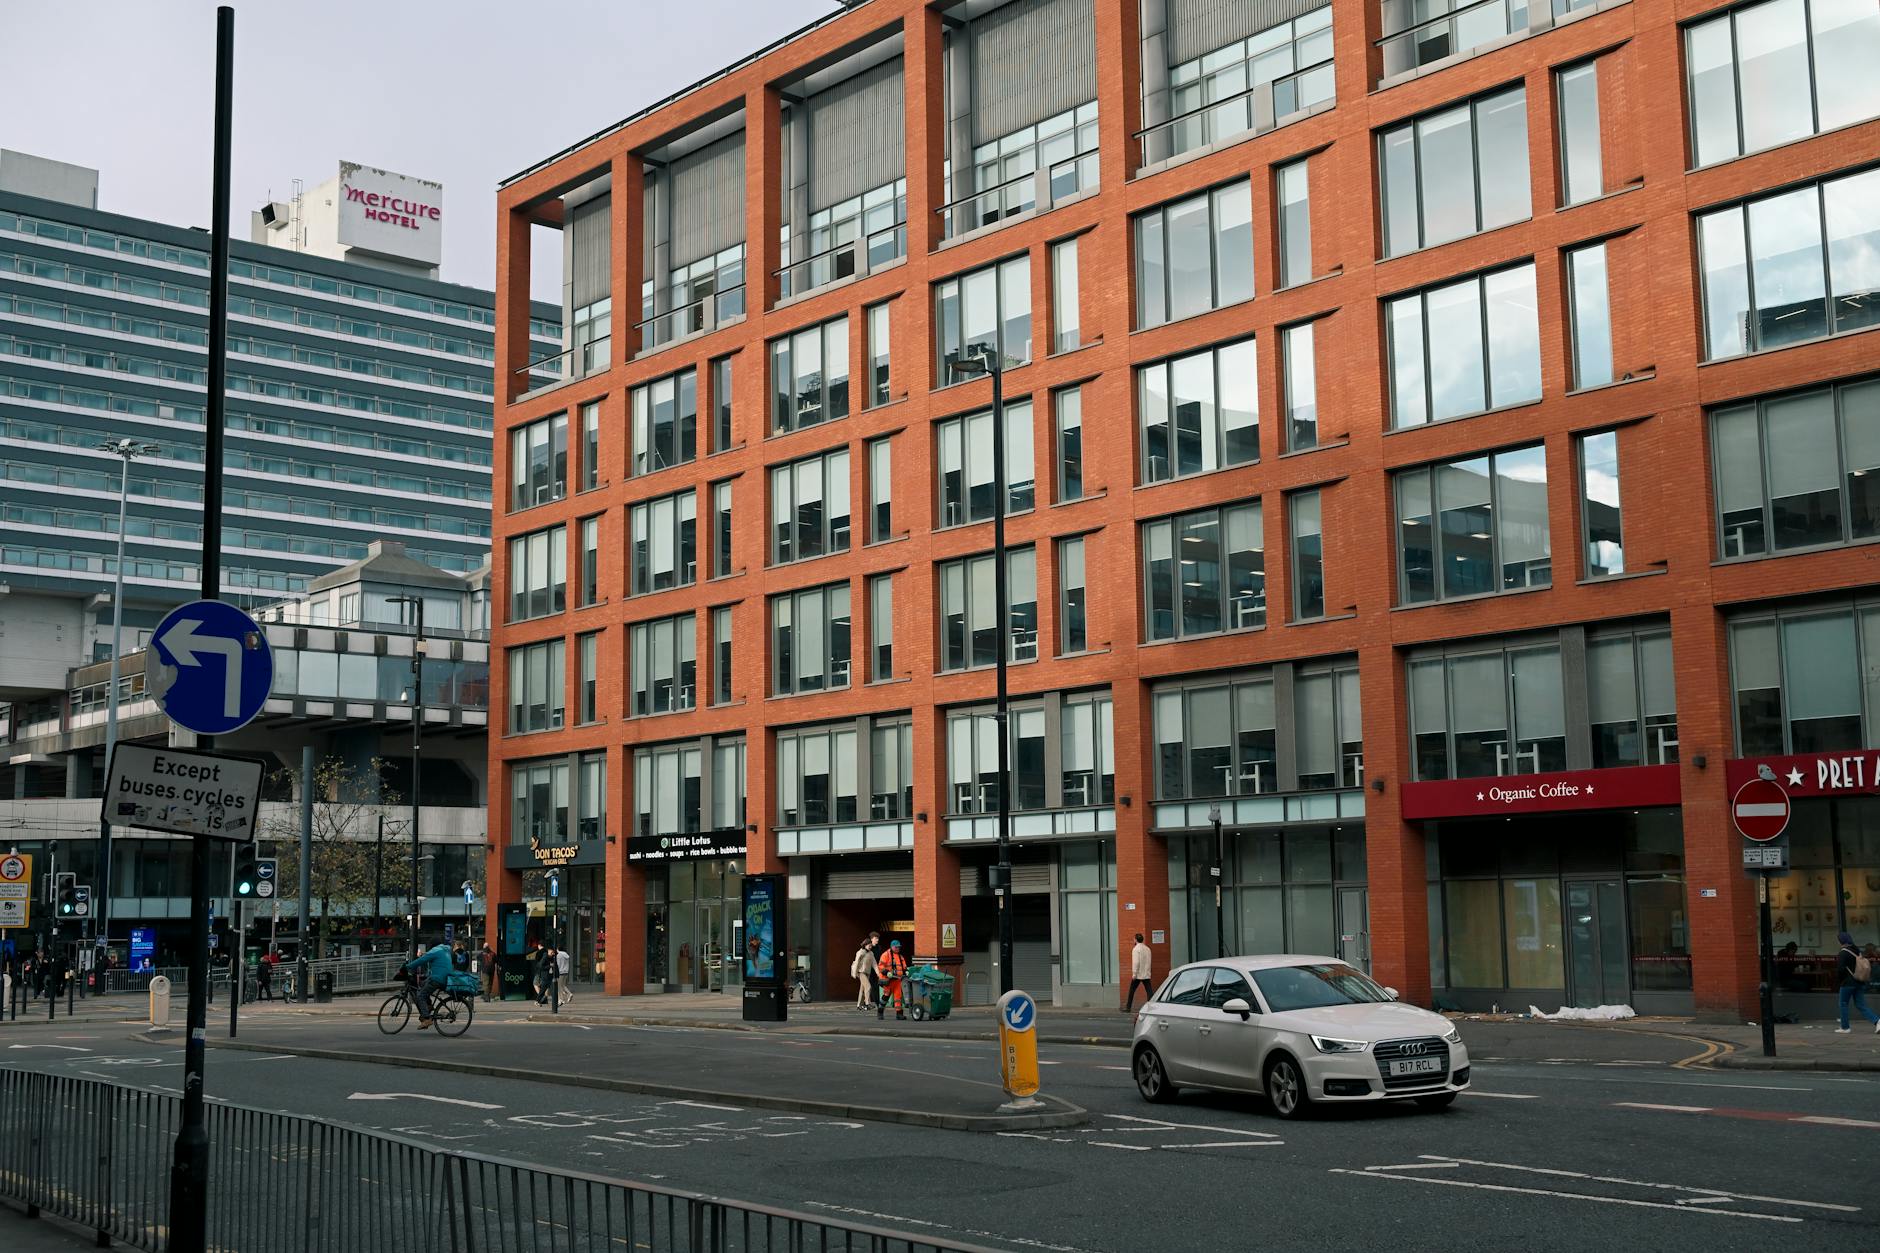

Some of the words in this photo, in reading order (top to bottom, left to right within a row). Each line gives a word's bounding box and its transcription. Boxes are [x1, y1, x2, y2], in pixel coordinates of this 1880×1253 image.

[365, 208, 419, 230] HOTEL
[153, 756, 221, 782] Except
[1817, 756, 1864, 789] PRET
[183, 788, 245, 808] cycles
[1489, 785, 1536, 804] Organic
[1539, 781, 1579, 798] Coffee
[672, 837, 690, 847] Little
[691, 836, 711, 846] Lotus
[535, 848, 550, 859] DON
[629, 851, 642, 859] sushi
[645, 850, 664, 859] noodles
[669, 850, 684, 859] soups
[689, 848, 700, 856] rice
[700, 847, 716, 856] bowls
[720, 845, 738, 854] bubble
[1399, 1061, 1413, 1073] B17
[1415, 1060, 1433, 1071] RCL
